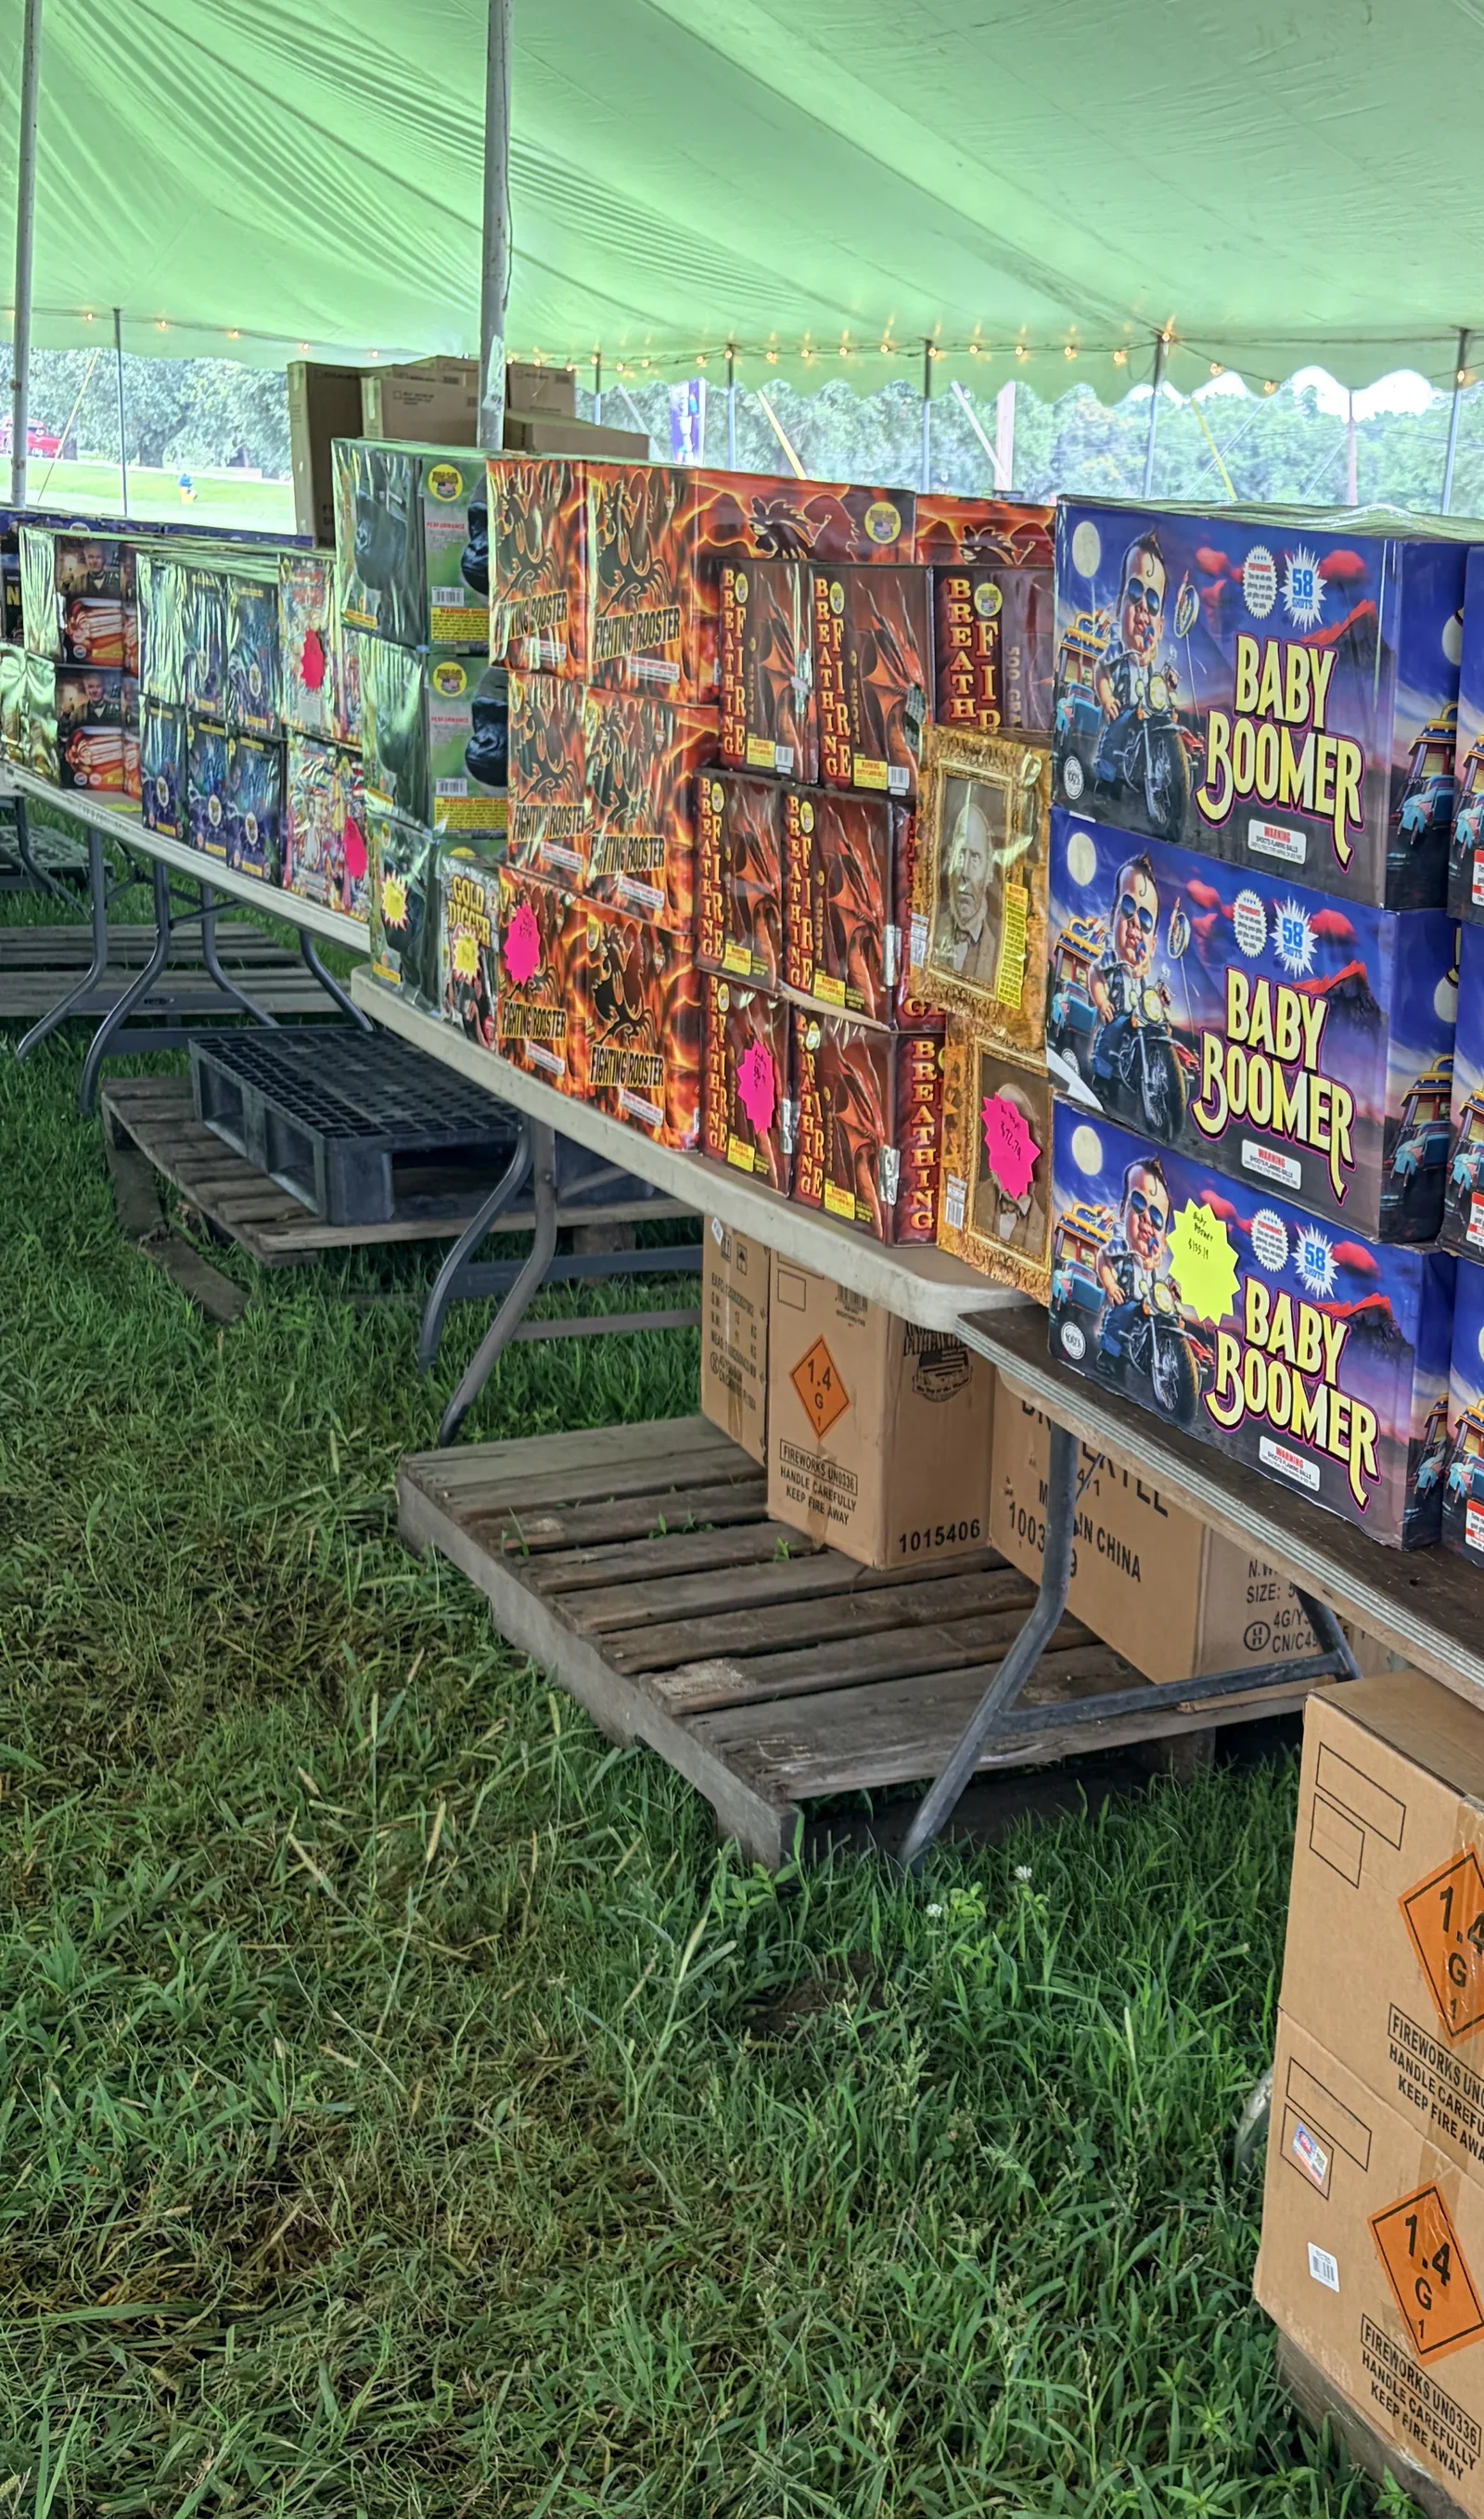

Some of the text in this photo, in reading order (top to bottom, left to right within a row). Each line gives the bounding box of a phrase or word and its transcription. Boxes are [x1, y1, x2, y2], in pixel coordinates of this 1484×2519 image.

[1292, 568, 1313, 597] 58
[594, 608, 680, 661] FIGHTING ROOSTER
[723, 569, 736, 754] BREATHING
[947, 578, 977, 726] BREATH
[735, 606, 747, 755] FIRE
[814, 577, 838, 778] BREATHING
[832, 618, 851, 778] FIRE
[975, 621, 1002, 734] FIR
[1235, 634, 1336, 730] BABY
[1196, 710, 1362, 865] BOOMER
[589, 836, 625, 874] FHTING
[628, 836, 665, 871] ROOSTER
[700, 778, 713, 957] BREATHING
[1264, 825, 1291, 844] WARNING
[447, 900, 492, 948] DIGGER
[452, 875, 485, 915] GOLD
[712, 816, 723, 959] FIRE
[787, 795, 801, 988] BREATHING
[800, 836, 813, 992] FIRE
[1283, 917, 1304, 948] 58
[502, 999, 567, 1039] FIGHTING ROOSTER
[1225, 967, 1327, 1072] BABY
[589, 1047, 628, 1086] FIGHTING
[628, 1052, 665, 1086] ROOSTER
[709, 975, 720, 1149] BREATHING
[718, 1015, 728, 1153] FIRE
[796, 1012, 813, 1195] BREATHING
[807, 1053, 825, 1200] FIRE
[910, 1039, 938, 1231] BREATHING
[1192, 1030, 1354, 1199] BOOMER
[1259, 1147, 1286, 1169] WARNING
[1304, 1240, 1326, 1272] 58
[1245, 1276, 1349, 1385] BABY
[806, 1357, 832, 1392] 1.4
[813, 1392, 825, 1410] G
[816, 1415, 823, 1427] 1
[1205, 1330, 1378, 1508] BOOMER
[780, 1465, 856, 1512] HANDLE CAREFULLY
[784, 1445, 825, 1477] FIREWORKS
[1275, 1446, 1304, 1470] WARNING
[1299, 1469, 1311, 1480] BALLS
[786, 1484, 850, 1526] KEEP FIRE AWAY
[898, 1518, 981, 1555] 1015406
[1079, 1511, 1141, 1583] IN CHINA
[1247, 1580, 1297, 1604] SIZE: 5
[1273, 1608, 1309, 1629] 4G/Y
[1439, 1884, 1484, 1960] 1.4
[1447, 1951, 1467, 1989] G
[1450, 1997, 1458, 2020] 1
[1392, 2012, 1461, 2088] FIREWORKS
[1389, 2043, 1484, 2138] HANDLE CAREFU
[1398, 2074, 1484, 2165] KEEP FIRE AWA
[1404, 2214, 1452, 2288] 1.4
[1415, 2277, 1433, 2311] G
[1418, 2319, 1425, 2340] 1
[1362, 2348, 1476, 2471] HANDLE CAREFULLY
[1365, 2322, 1478, 2448] FIREWORKS UN0336
[1371, 2380, 1465, 2481] KEEP FIRE AWAY
